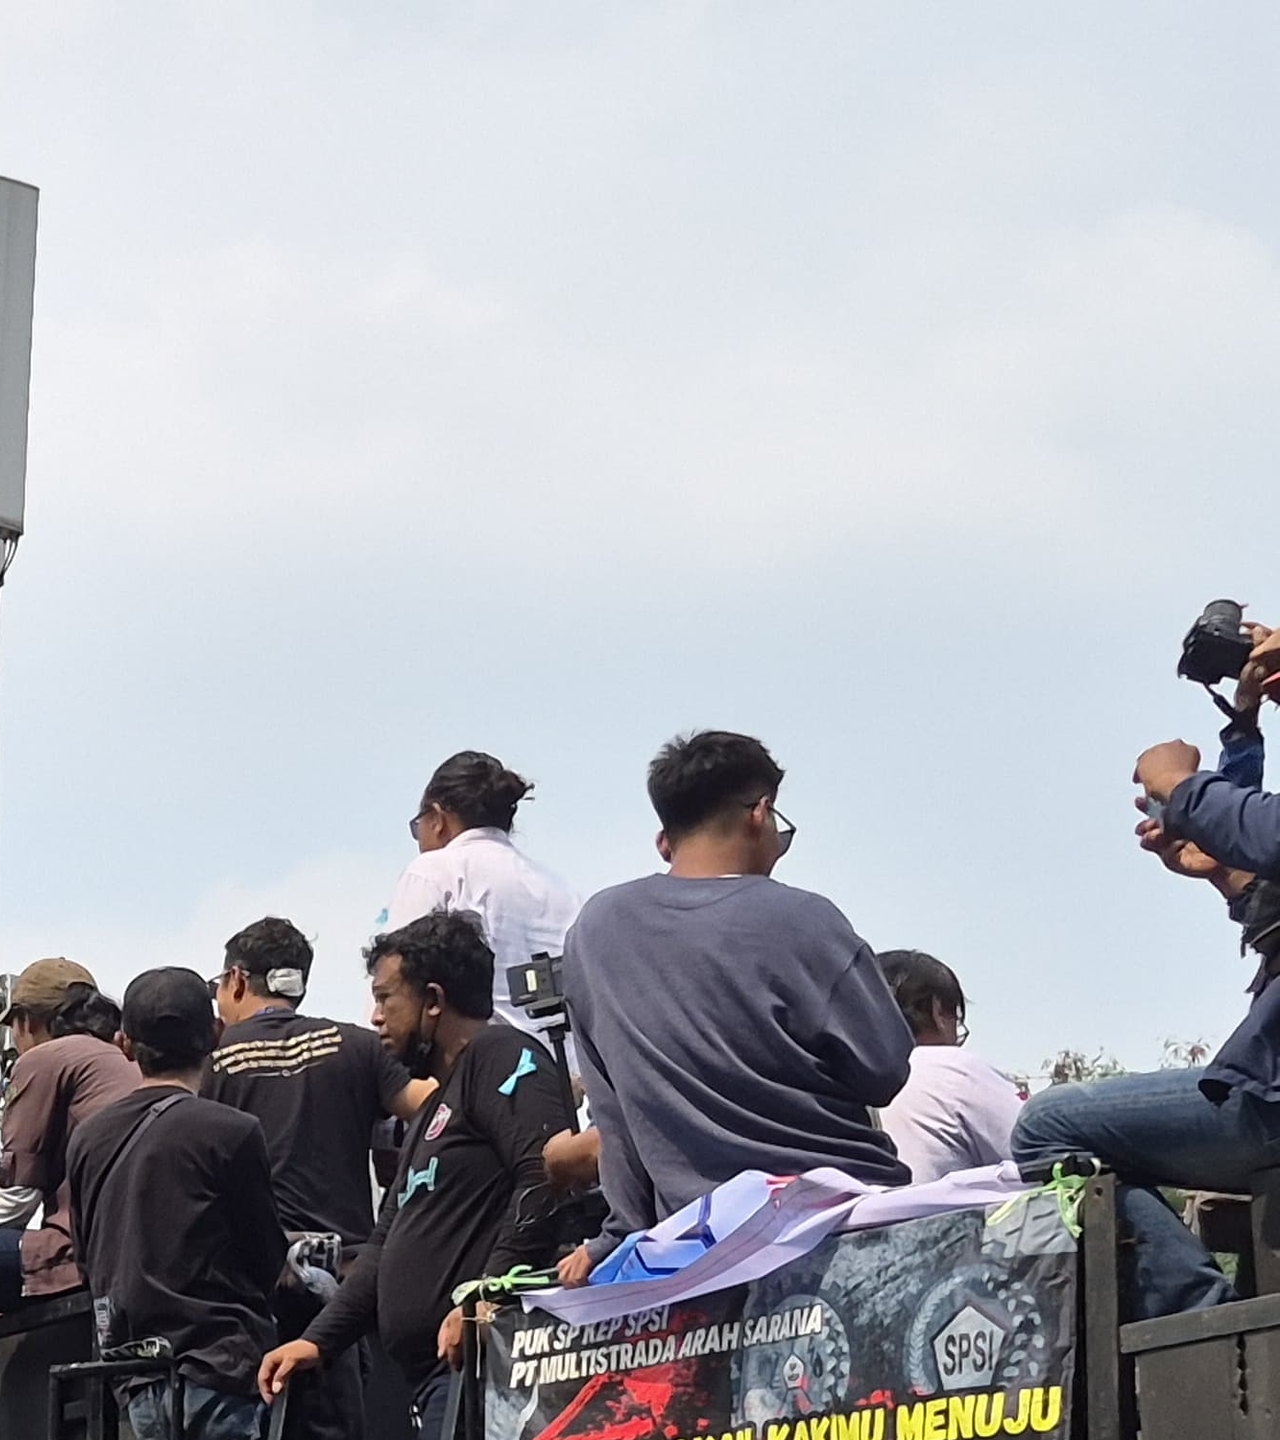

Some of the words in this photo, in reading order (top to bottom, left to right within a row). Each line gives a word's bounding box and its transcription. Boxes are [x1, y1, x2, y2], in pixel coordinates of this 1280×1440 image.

[509, 1358, 538, 1389] PT
[539, 1336, 675, 1384] MULTISTRADA
[678, 1322, 740, 1359] ARAH
[742, 1303, 823, 1347] SARANA
[510, 1325, 550, 1358] PUK
[553, 1325, 581, 1350] SP
[624, 1305, 669, 1338] SPSI
[943, 1329, 994, 1377] SPSI
